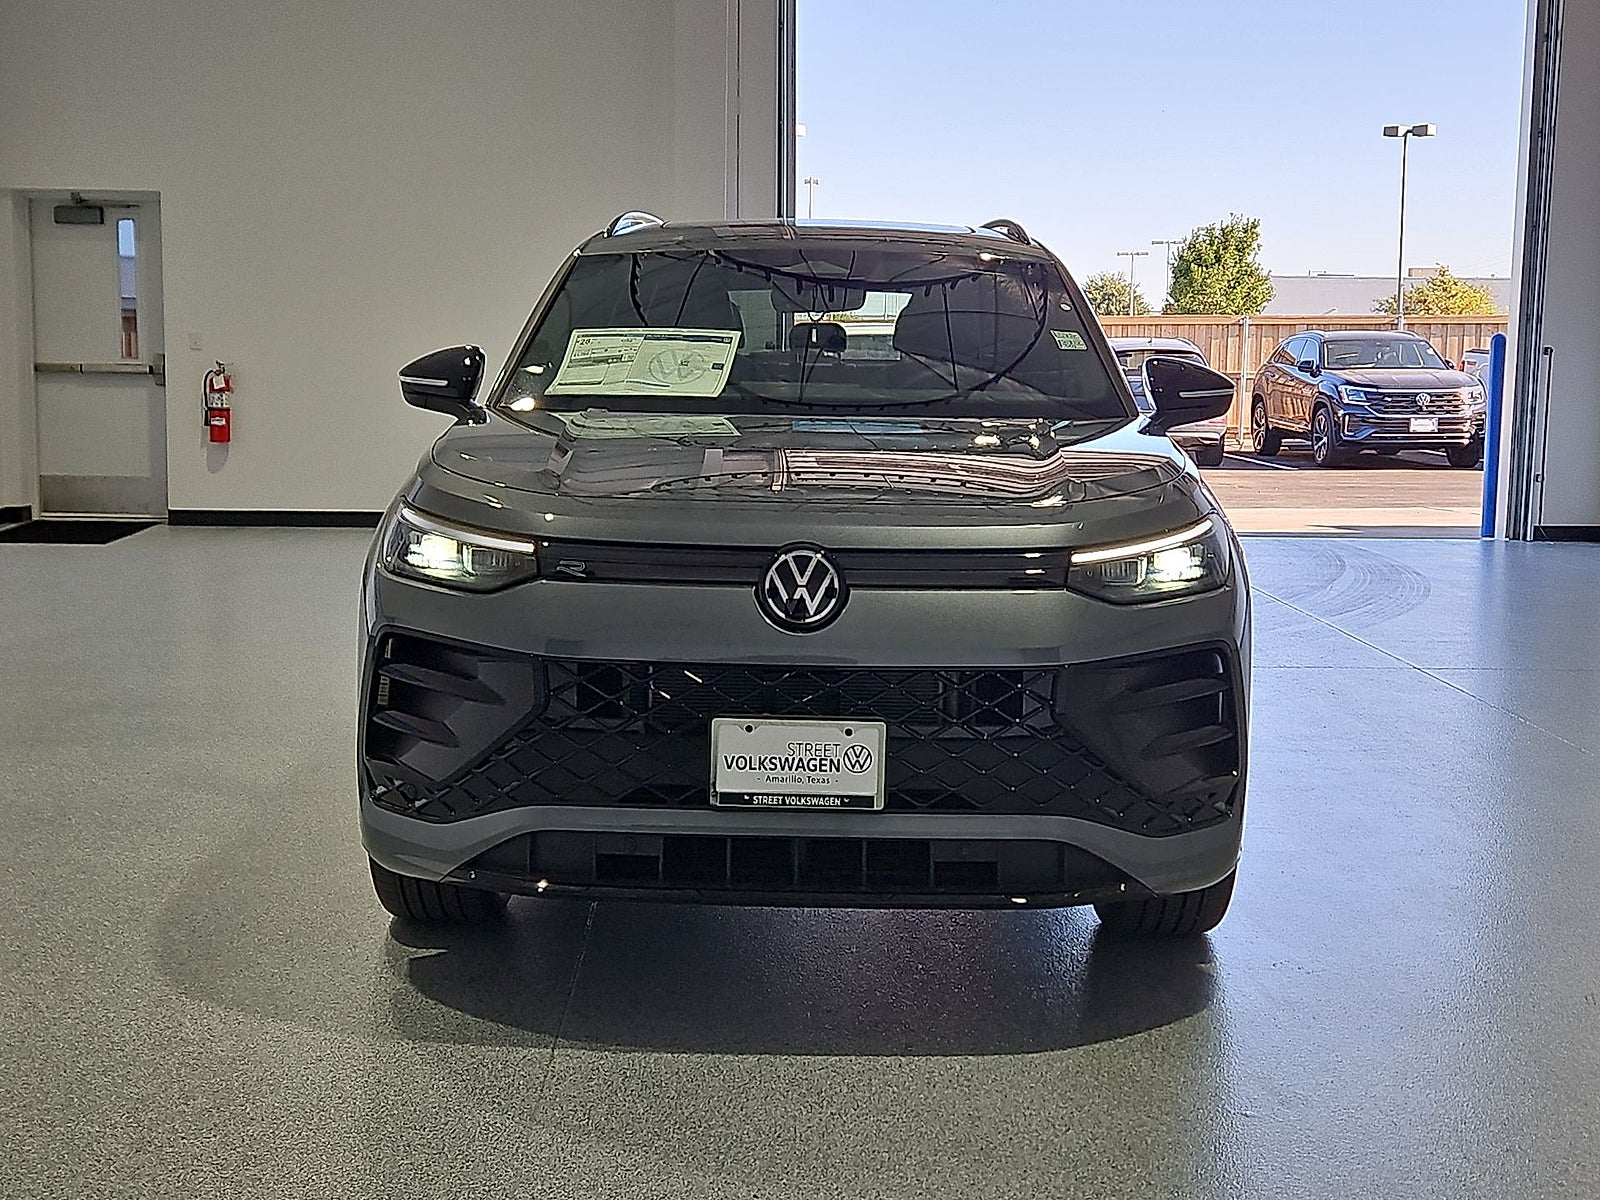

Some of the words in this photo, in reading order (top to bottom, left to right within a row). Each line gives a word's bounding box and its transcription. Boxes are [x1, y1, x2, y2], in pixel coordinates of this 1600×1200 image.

[786, 742, 841, 758] STREET
[723, 755, 841, 773] VOLKSWAGEN
[765, 774, 804, 784] Amarillo,
[806, 775, 831, 785] Texas
[752, 796, 784, 805] STREET
[785, 796, 841, 806] VOLKSWAGEN
